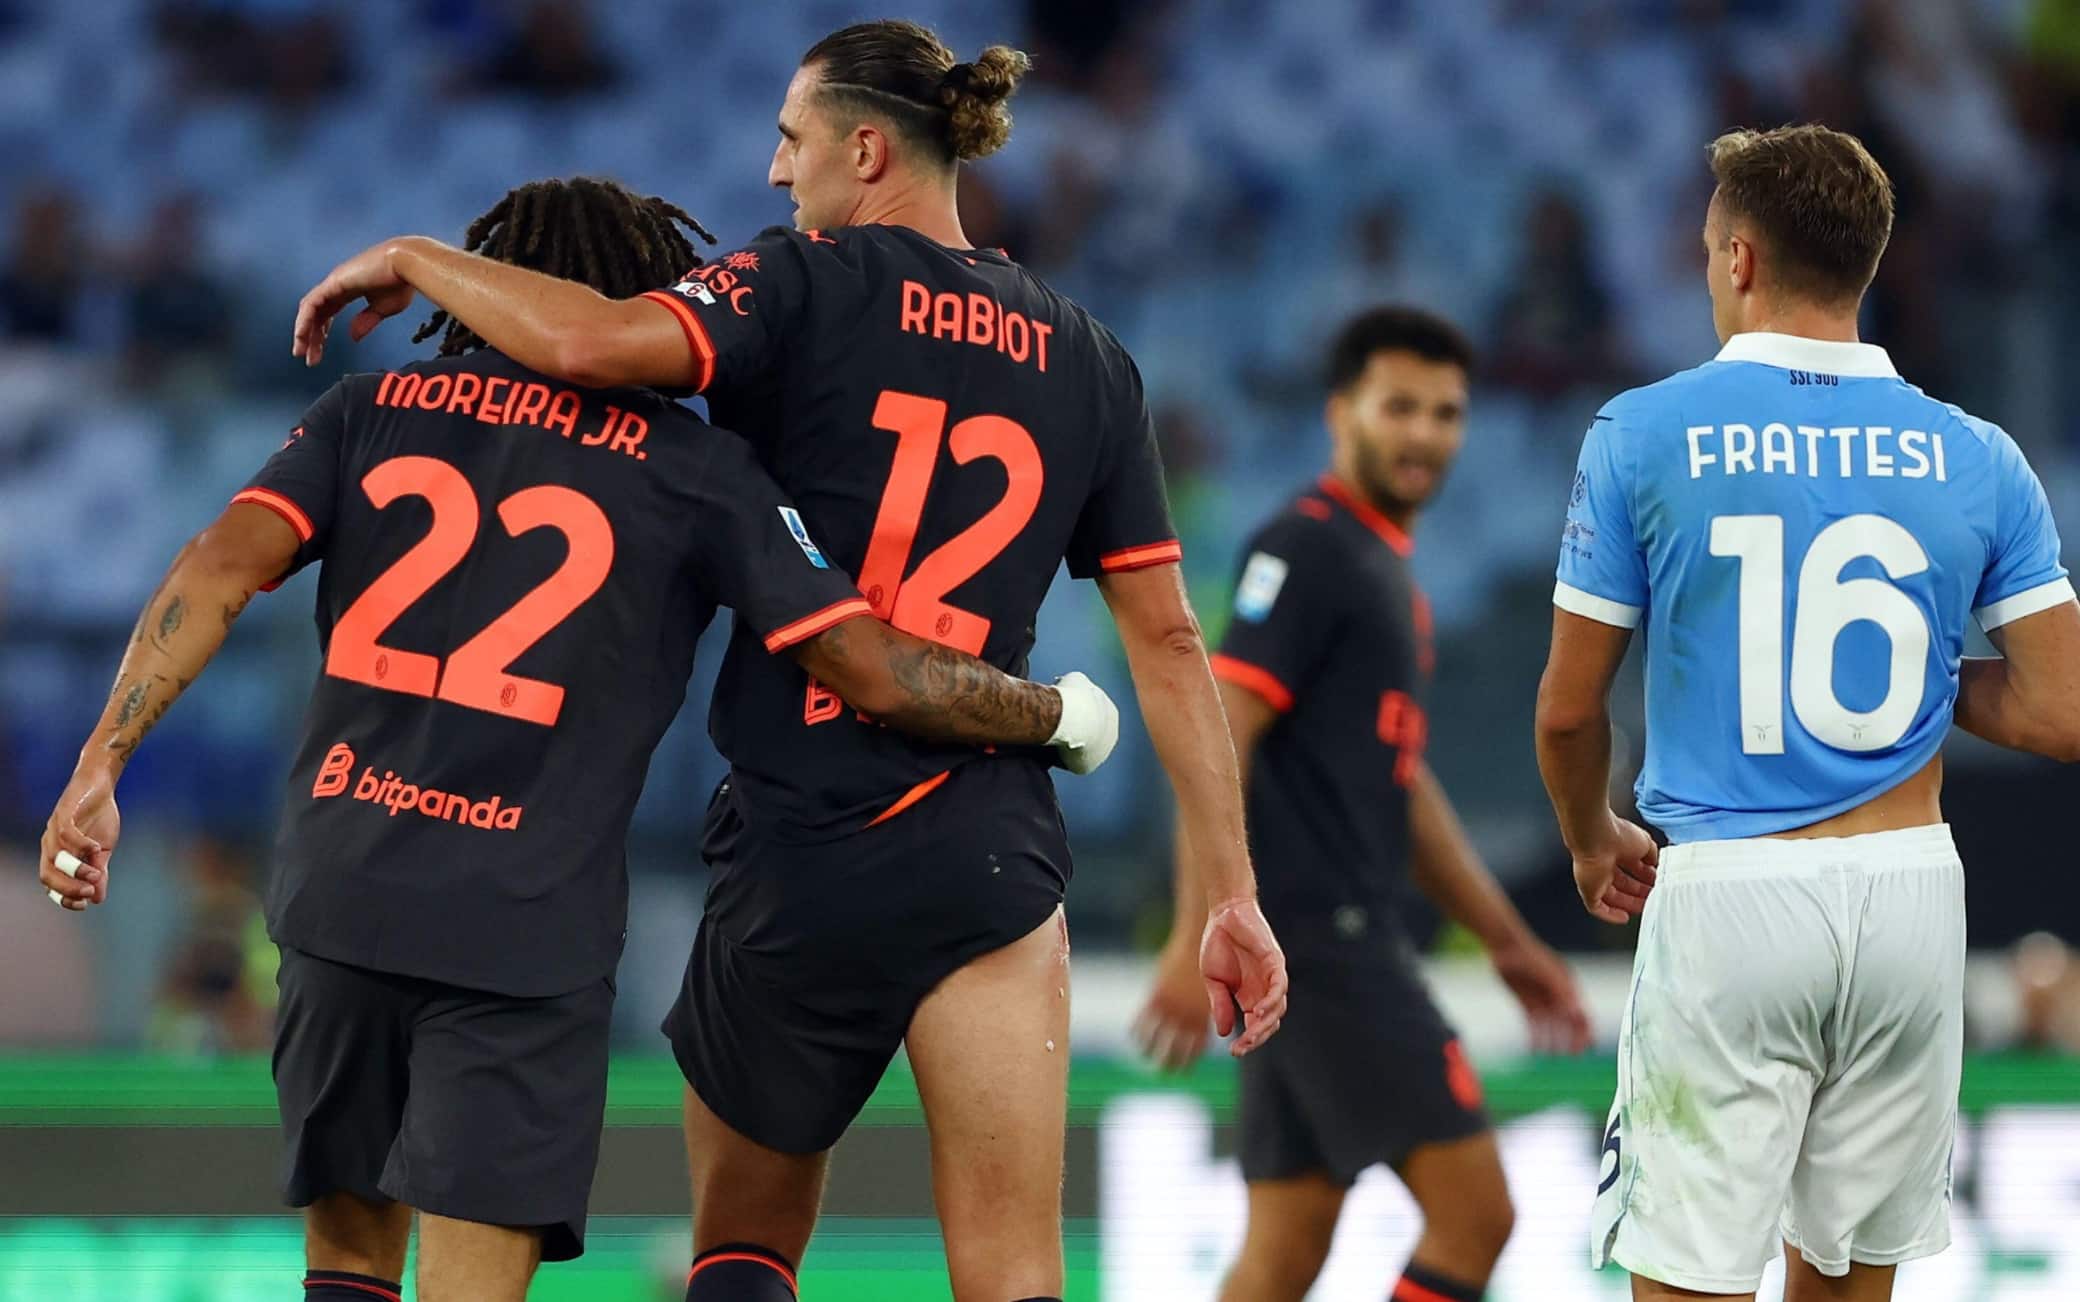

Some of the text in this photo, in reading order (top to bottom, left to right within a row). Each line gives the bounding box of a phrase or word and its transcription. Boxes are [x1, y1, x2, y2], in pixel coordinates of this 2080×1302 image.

[901, 280, 1053, 372] RABIOT
[375, 371, 649, 461] MOREIRA JR.
[1789, 368, 1812, 386] SSL
[1687, 422, 1947, 482] FRATTESI
[857, 389, 1044, 658] 12
[325, 455, 615, 727] 22
[1709, 514, 1930, 755] 16
[353, 766, 523, 832] bitpanda
